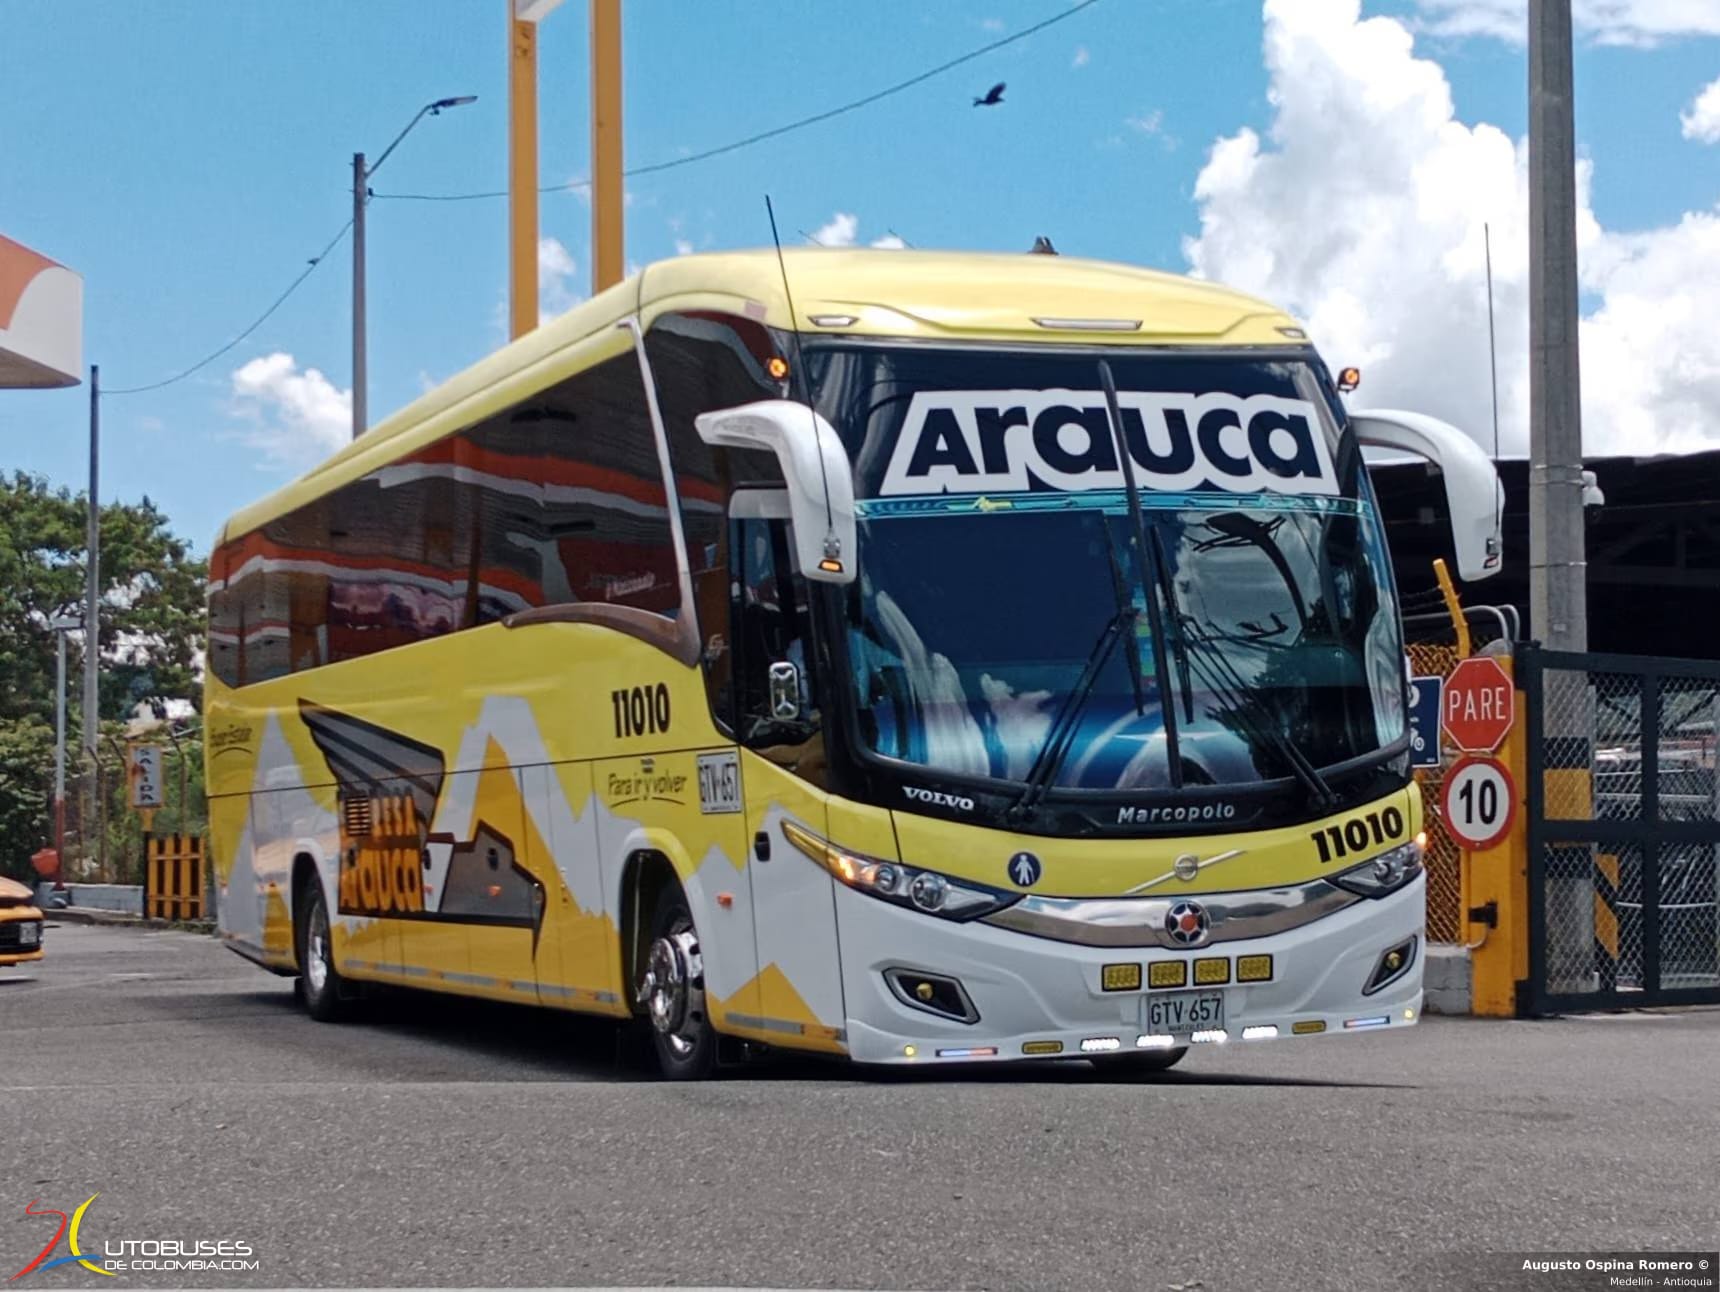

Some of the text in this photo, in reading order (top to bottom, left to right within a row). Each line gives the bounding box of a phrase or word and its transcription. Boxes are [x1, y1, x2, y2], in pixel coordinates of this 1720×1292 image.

[612, 681, 671, 739] 11010
[1450, 687, 1507, 722] PARE
[902, 786, 975, 811] VOLVO
[1117, 802, 1236, 825] Marcopolo
[1459, 778, 1498, 825] 10
[1310, 806, 1404, 864] 11010
